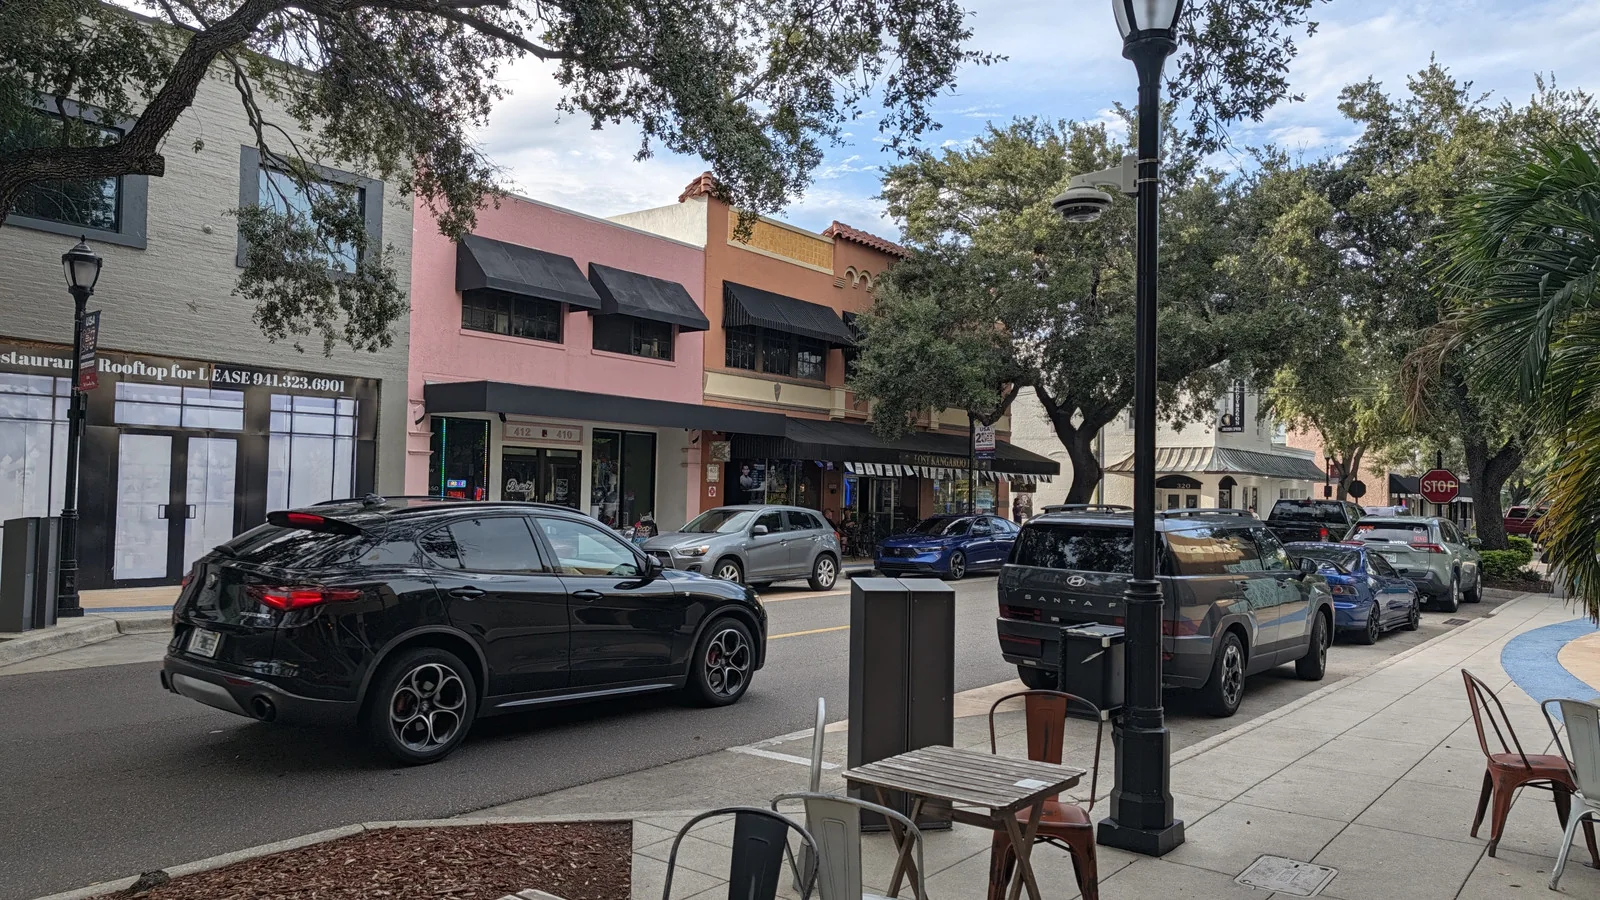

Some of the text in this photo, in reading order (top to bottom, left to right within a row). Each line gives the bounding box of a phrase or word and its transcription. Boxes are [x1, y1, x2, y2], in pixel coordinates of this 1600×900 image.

[0, 351, 74, 369] stauran
[98, 357, 168, 381] Rooftop
[170, 365, 197, 381] for
[252, 372, 345, 393] 941.323.6901
[513, 427, 532, 437] 412
[556, 430, 573, 439] 410
[914, 454, 931, 465] LOST
[931, 455, 967, 468] KANGAROO
[1423, 480, 1456, 493] STOP
[1024, 594, 1093, 607] SANTA
